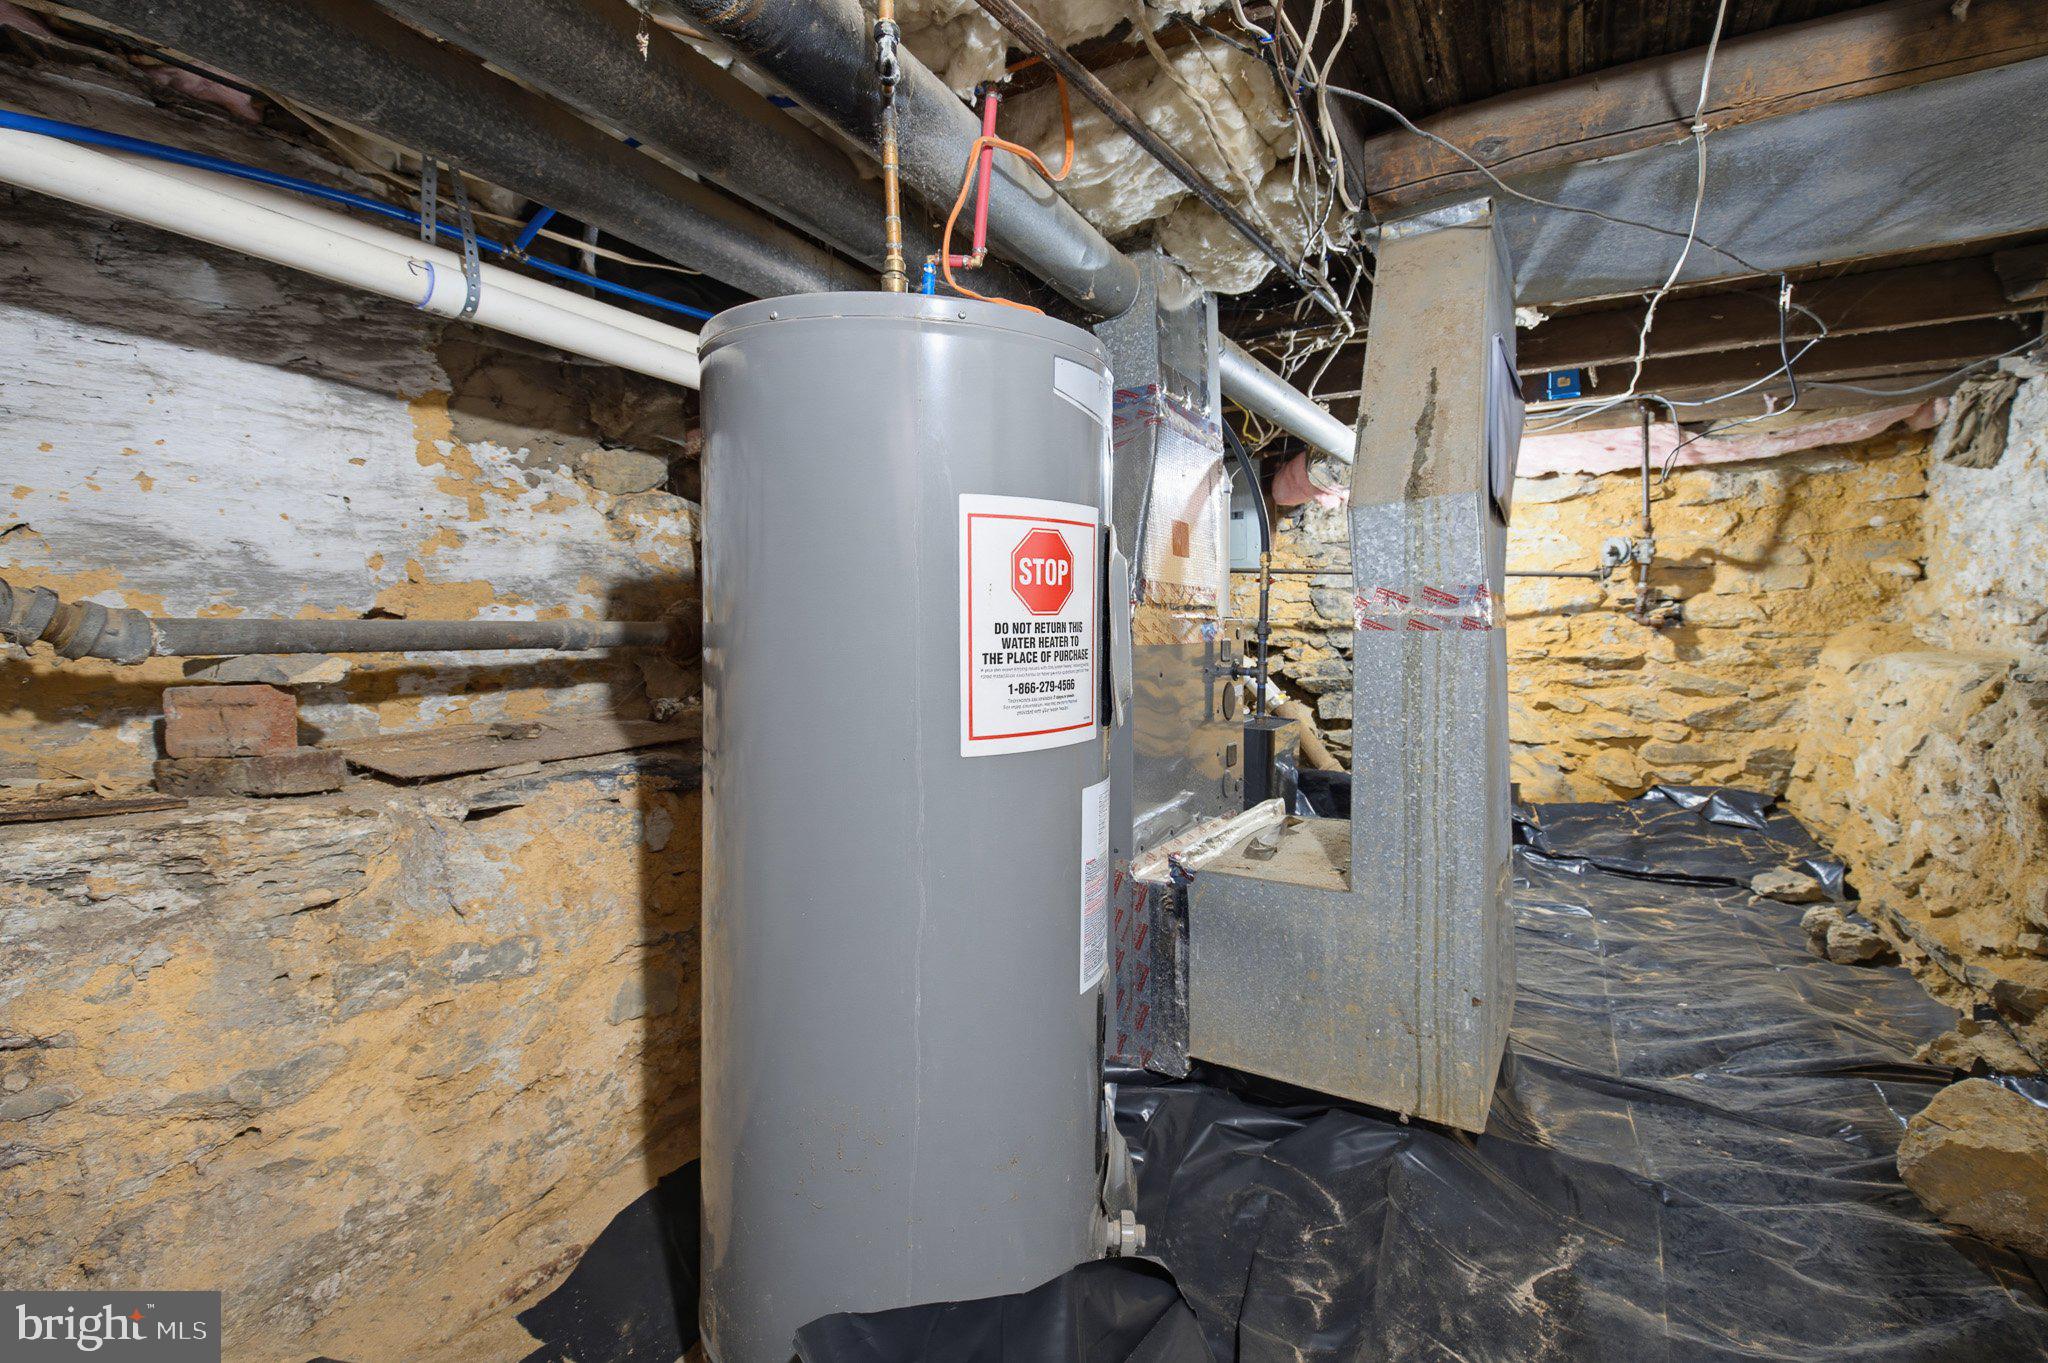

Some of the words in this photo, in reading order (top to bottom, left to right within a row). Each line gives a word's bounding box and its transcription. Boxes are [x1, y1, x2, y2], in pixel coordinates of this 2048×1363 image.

[1019, 557, 1069, 586] STOP
[994, 622, 1009, 635] DO
[1012, 622, 1032, 635] NOT
[1034, 621, 1067, 634] RETURN
[1068, 621, 1083, 633] THIS
[1001, 637, 1036, 649] WATER
[1038, 636, 1069, 648] HEATER
[1070, 635, 1080, 647] TO
[982, 652, 1003, 665] THE
[1006, 651, 1038, 664] PLACE
[1040, 650, 1052, 663] OF
[1053, 648, 1089, 662] PURCHASE
[1008, 678, 1075, 695] 1-866-279-4566
